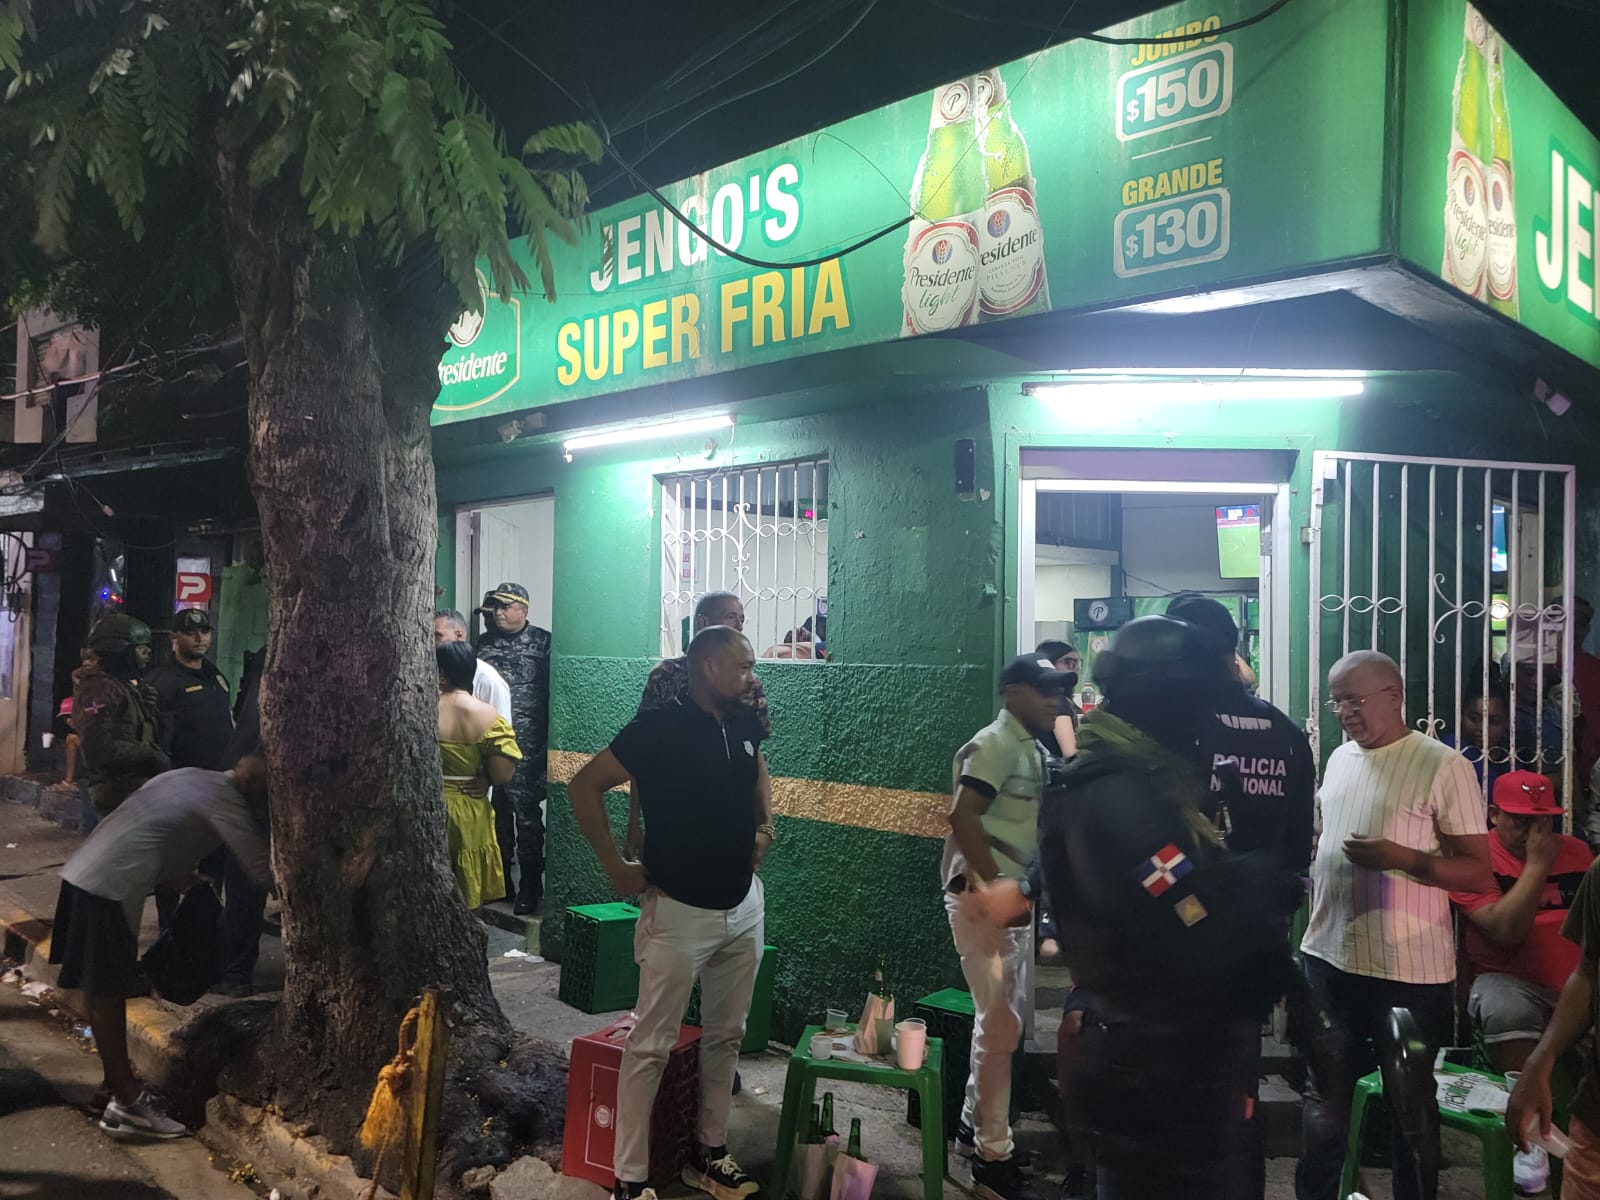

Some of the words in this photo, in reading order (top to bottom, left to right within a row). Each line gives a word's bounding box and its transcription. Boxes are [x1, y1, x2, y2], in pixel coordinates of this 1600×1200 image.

[1130, 16, 1220, 66] JUMBO
[1126, 59, 1220, 123] $150
[1122, 158, 1223, 206] GRANDE
[590, 163, 799, 292] JENGO'S
[980, 228, 1038, 267] esidente
[1125, 201, 1218, 258] $130
[1536, 149, 1600, 322] JE
[910, 265, 976, 288] Presidente
[919, 284, 960, 316] light
[557, 292, 701, 386] SUPER
[721, 257, 850, 353] FRIA
[438, 351, 508, 386] residente
[1210, 773, 1285, 797] NIONAL
